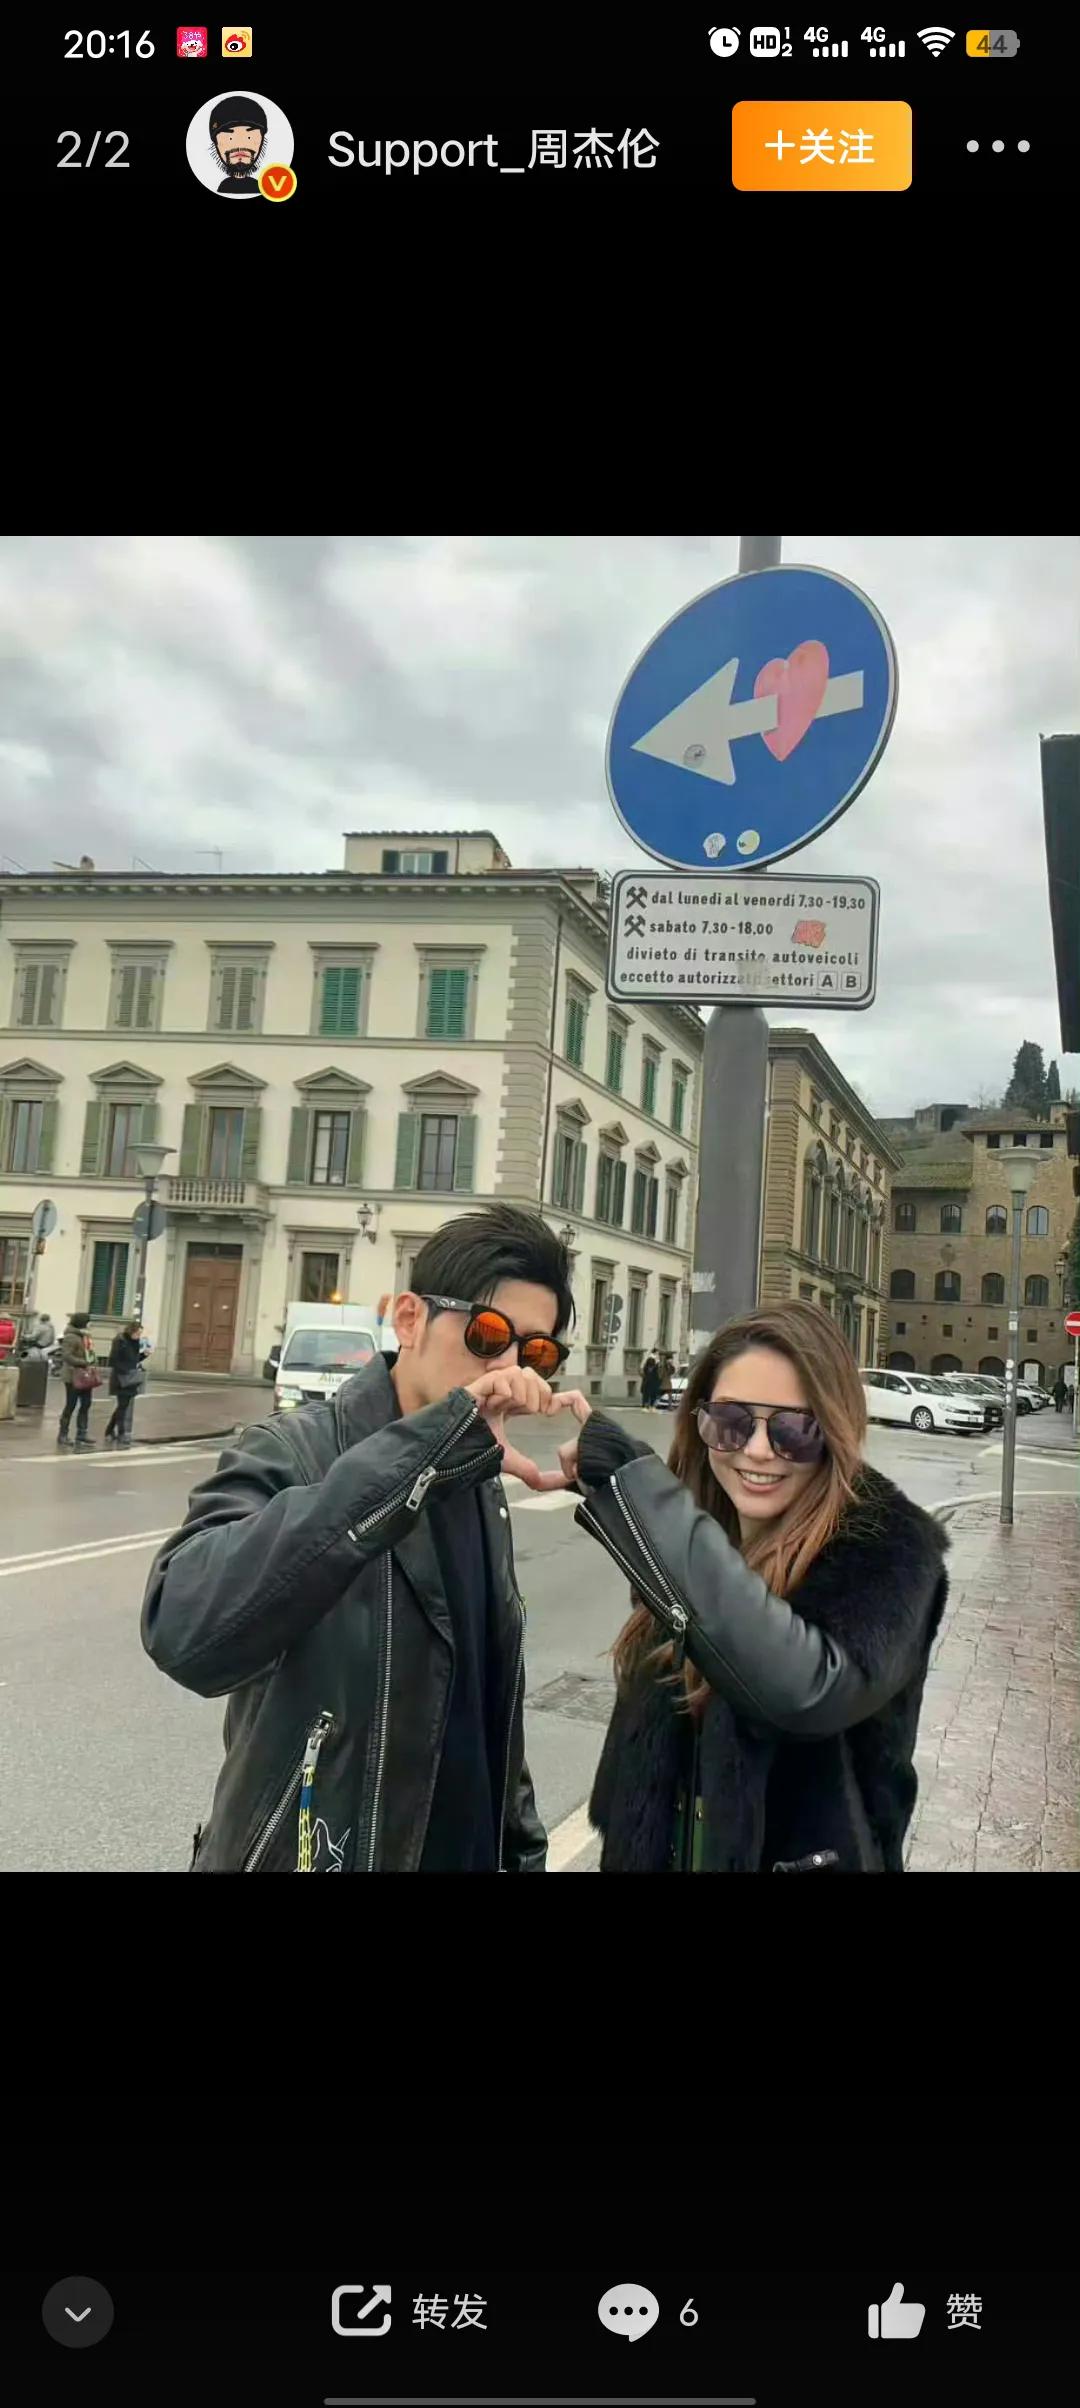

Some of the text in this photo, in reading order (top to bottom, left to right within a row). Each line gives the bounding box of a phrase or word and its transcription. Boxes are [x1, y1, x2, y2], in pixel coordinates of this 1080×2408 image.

[651, 891, 673, 905] dal
[678, 891, 722, 906] lunedi
[725, 892, 739, 906] al
[743, 894, 796, 907] venerdi
[649, 920, 697, 934] sabato
[626, 946, 677, 961] divieto
[684, 947, 697, 961] di
[772, 951, 858, 966] autoveicoli
[620, 970, 674, 983] eccetto
[821, 974, 834, 988] A
[845, 975, 858, 989] B
